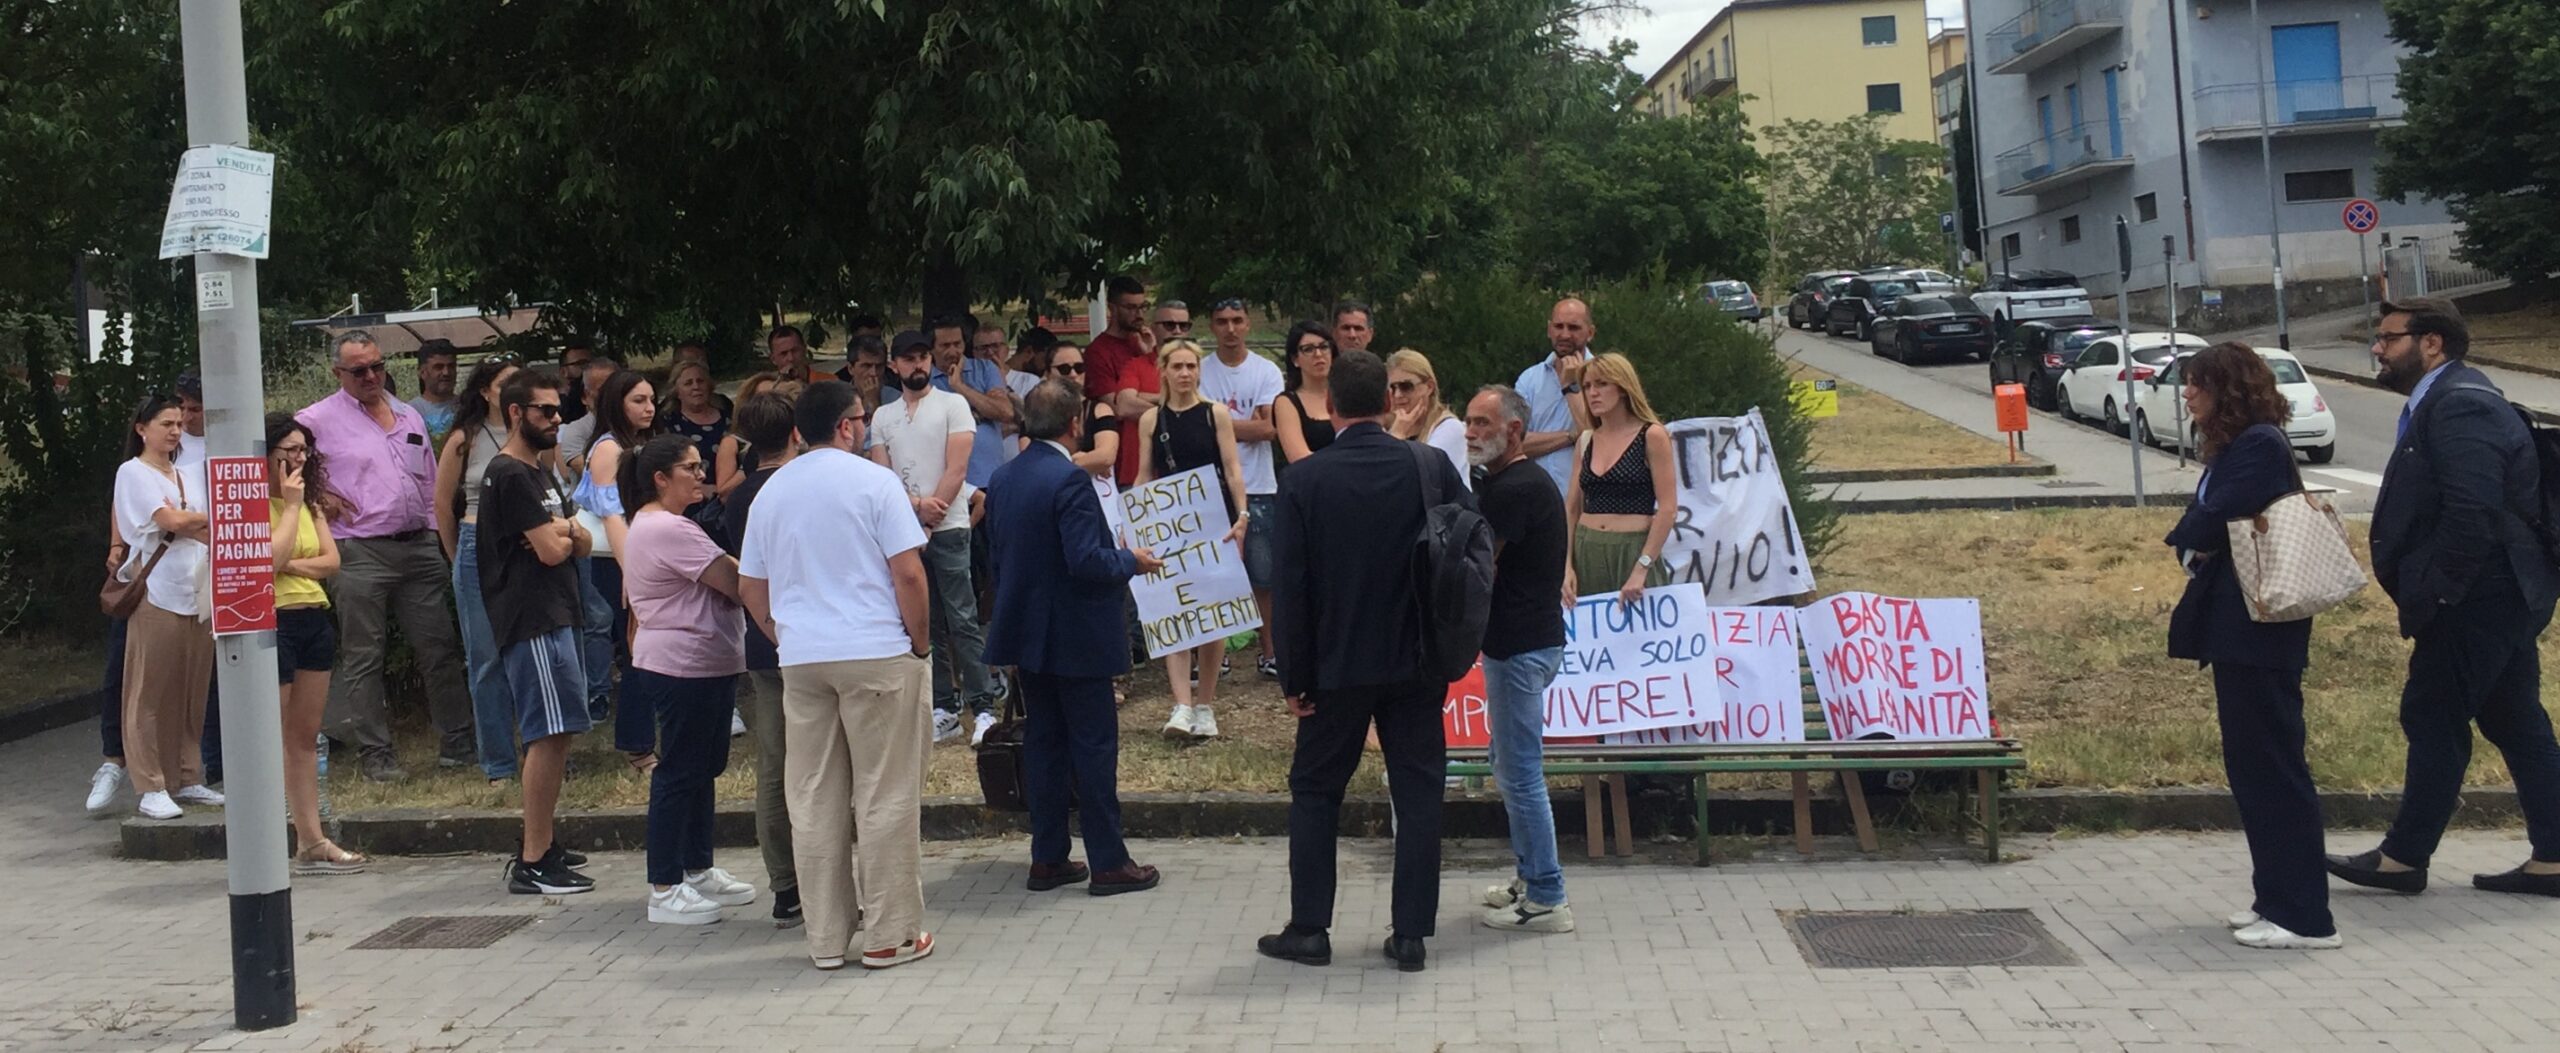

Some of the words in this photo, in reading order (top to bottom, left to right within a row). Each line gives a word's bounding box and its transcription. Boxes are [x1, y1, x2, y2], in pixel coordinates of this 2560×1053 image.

[217, 158, 264, 173] VENDITA
[1942, 215, 1952, 227] P
[215, 462, 263, 481] VERITA'
[1673, 420, 1768, 489] TIZIA
[216, 484, 223, 501] E
[1123, 472, 1206, 523] BASTA
[216, 503, 242, 520] PER
[1135, 511, 1202, 548] MEDICI
[1176, 582, 1198, 605] E
[1144, 592, 1261, 652] INCOMPETENTI
[1563, 594, 1679, 642] NTONIO
[1712, 611, 1792, 647] IZIA
[1830, 594, 1931, 642] BASTA
[1558, 646, 1616, 675] EVA
[1640, 633, 1706, 667] SOLO
[1823, 637, 1918, 693] MORRE
[1930, 646, 1963, 685] DI
